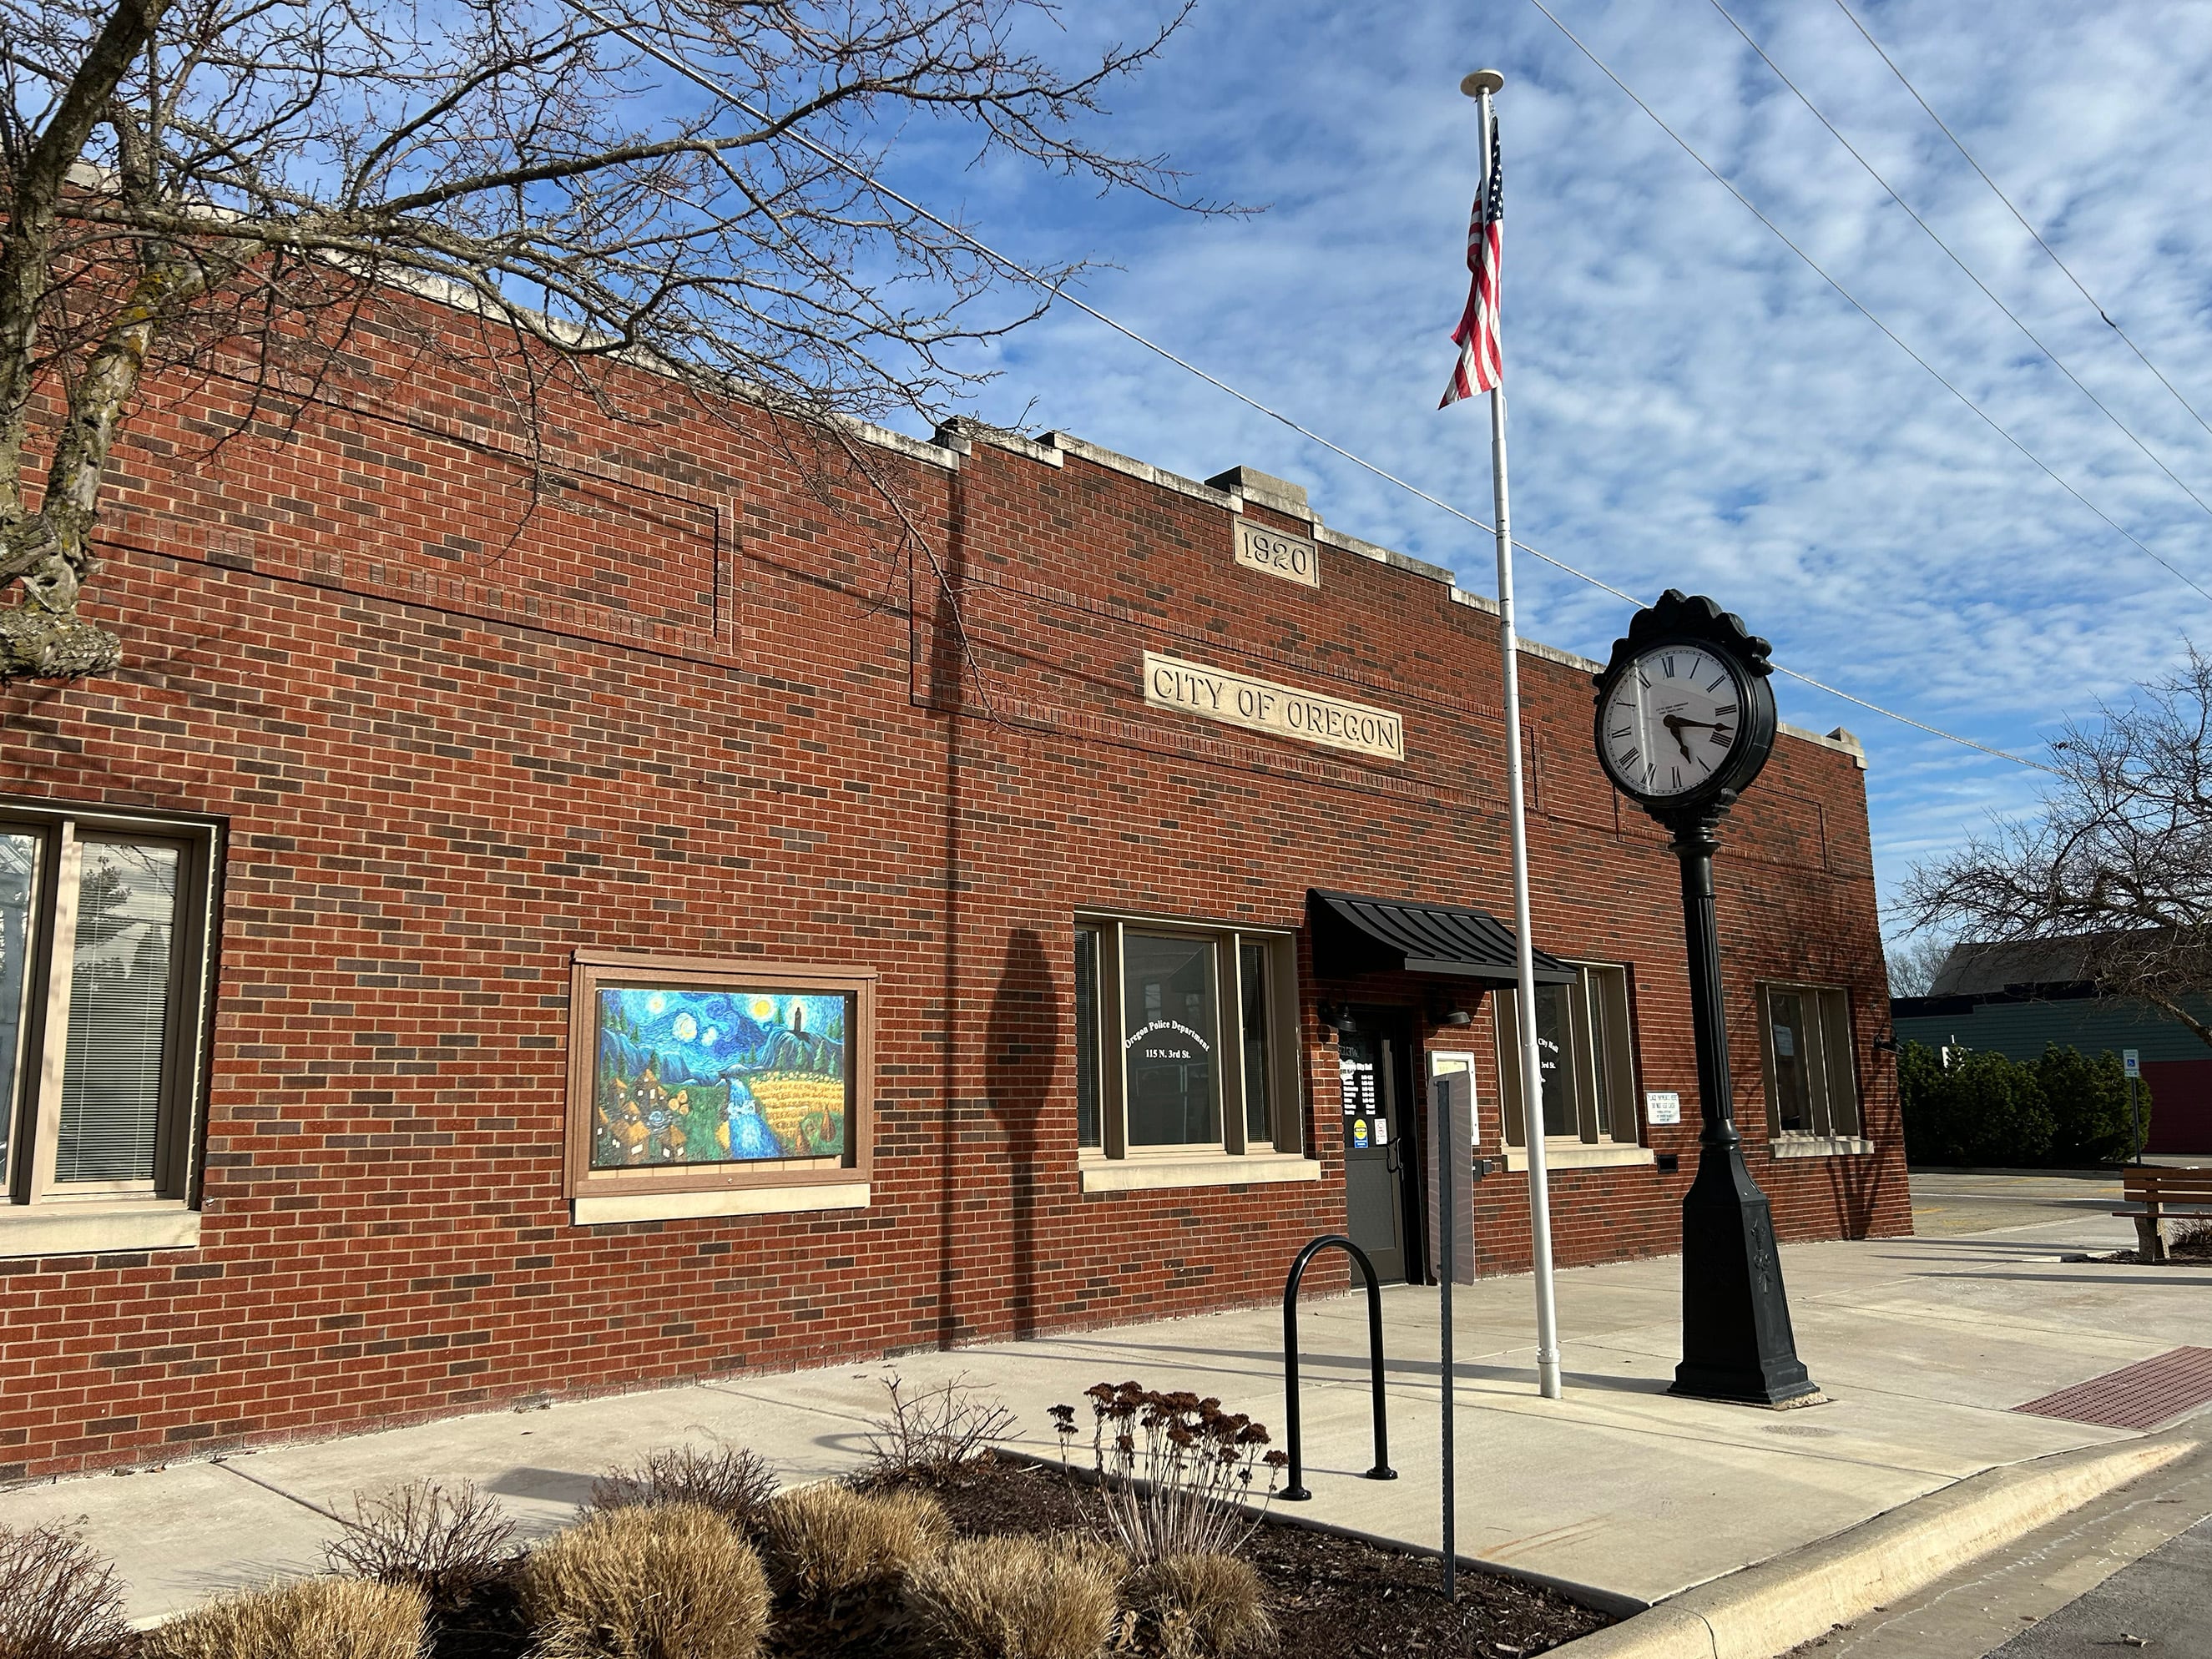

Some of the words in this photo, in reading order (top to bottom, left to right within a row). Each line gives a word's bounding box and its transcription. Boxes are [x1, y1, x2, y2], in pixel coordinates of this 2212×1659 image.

[1244, 531, 1307, 576] 1920
[1153, 667, 1223, 709] CITY
[1237, 686, 1275, 720] OF
[1286, 698, 1396, 750] OREGON
[1124, 1026, 1149, 1049] Oregon
[1149, 1019, 1170, 1031] Police
[1171, 1020, 1210, 1052] Department
[1145, 1049, 1158, 1058] 115
[1159, 1049, 1167, 1058] N.
[1168, 1050, 1180, 1059] 3rd
[1181, 1050, 1191, 1059] St.
